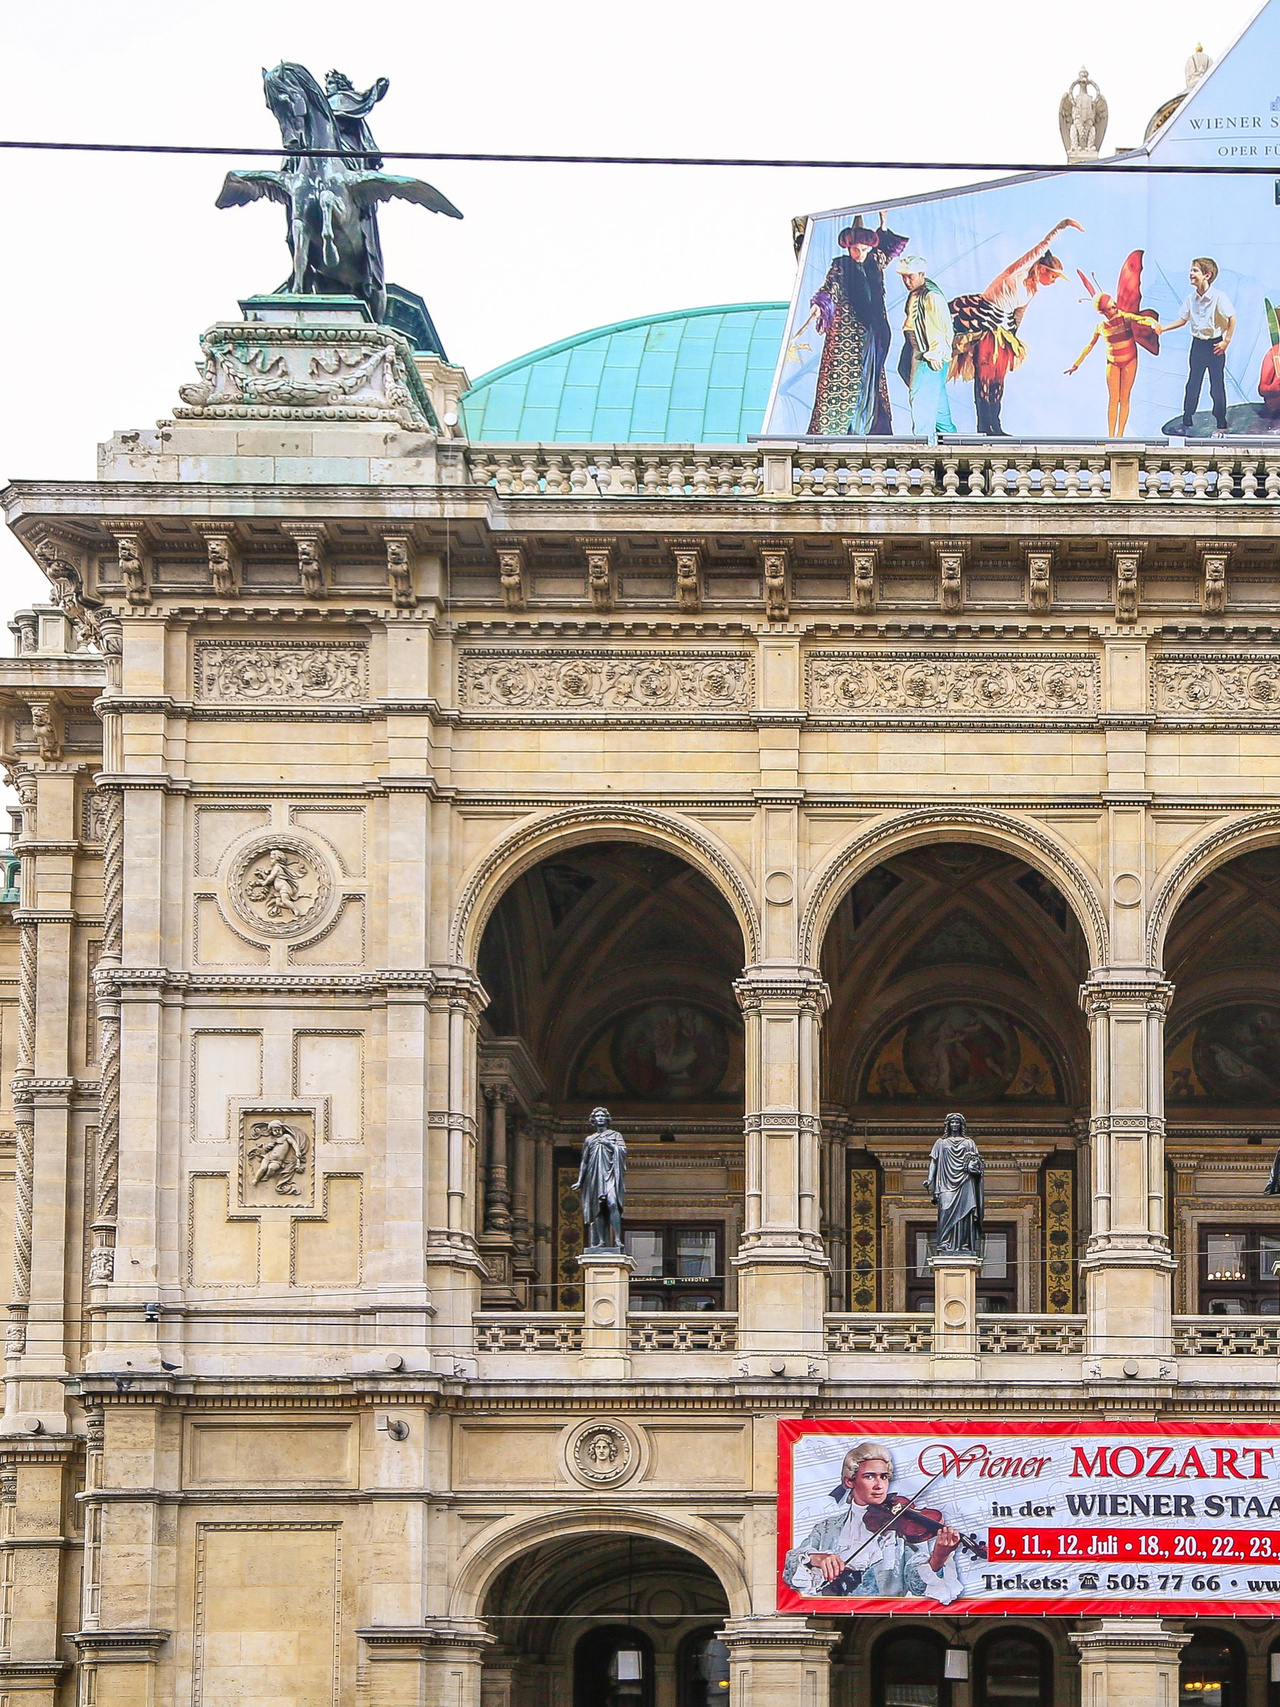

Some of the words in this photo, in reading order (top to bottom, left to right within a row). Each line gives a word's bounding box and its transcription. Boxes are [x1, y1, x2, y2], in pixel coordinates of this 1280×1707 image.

[1188, 116, 1262, 130] WIENER
[1217, 145, 1258, 157] OPER
[917, 1444, 1051, 1478] Wiener
[1069, 1445, 1274, 1479] MOZART
[991, 1501, 1013, 1517] in
[1019, 1500, 1056, 1518] der
[1066, 1494, 1197, 1518] WIENER
[993, 1534, 1017, 1558] 9.,
[1021, 1534, 1052, 1558] 11.,
[1057, 1534, 1083, 1556] 12.
[1087, 1535, 1118, 1556] Juli
[1138, 1535, 1169, 1558] 18.,
[1174, 1535, 1207, 1559] 20.,
[1211, 1536, 1245, 1560] 22.,
[981, 1573, 1069, 1591] Tickets:
[1106, 1574, 1150, 1591] 505
[1157, 1574, 1184, 1591] 77
[1191, 1574, 1221, 1592] 66
